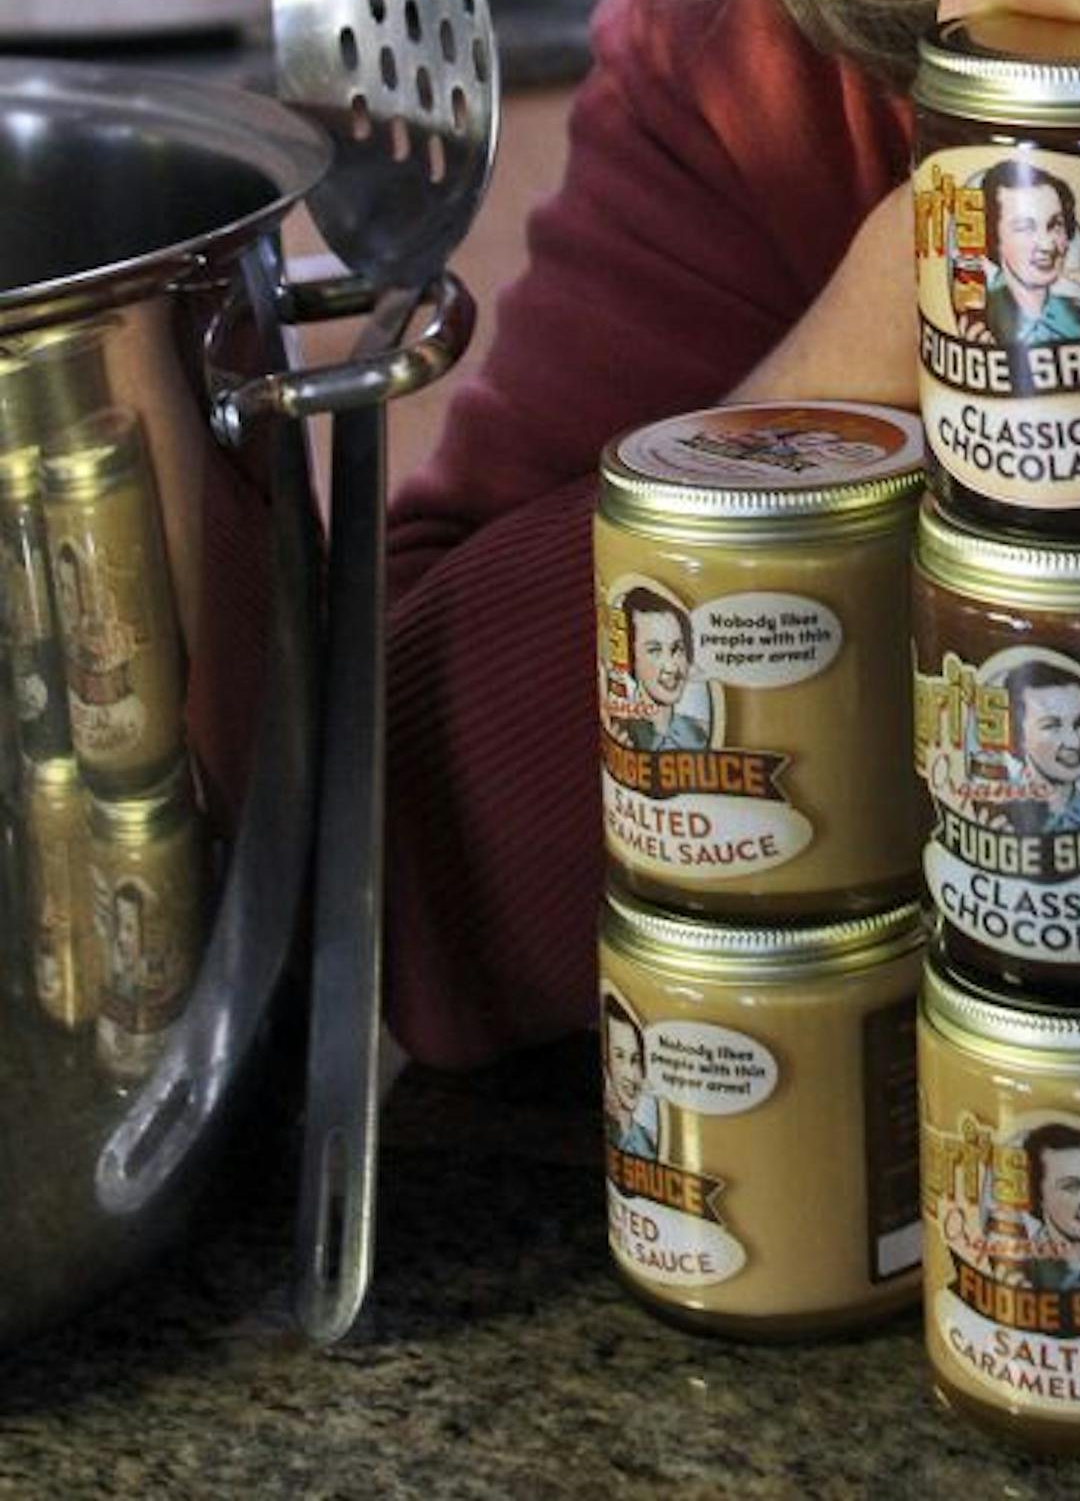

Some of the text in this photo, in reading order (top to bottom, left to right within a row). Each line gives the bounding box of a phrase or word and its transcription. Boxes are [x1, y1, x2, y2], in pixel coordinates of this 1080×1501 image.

[922, 326, 1012, 391] FUDGE
[700, 632, 754, 648] people
[759, 630, 795, 646] with
[710, 612, 777, 632] Nobody
[715, 653, 764, 667] upper
[658, 753, 765, 794] SAUCE
[607, 811, 780, 866] RAMEL SAUCE
[614, 787, 711, 839] SALTED
[947, 821, 1041, 875] FUDGE
[623, 1154, 704, 1214] SAUCE
[635, 1242, 716, 1274] SAUCE
[959, 1267, 1062, 1330] FUDGE
